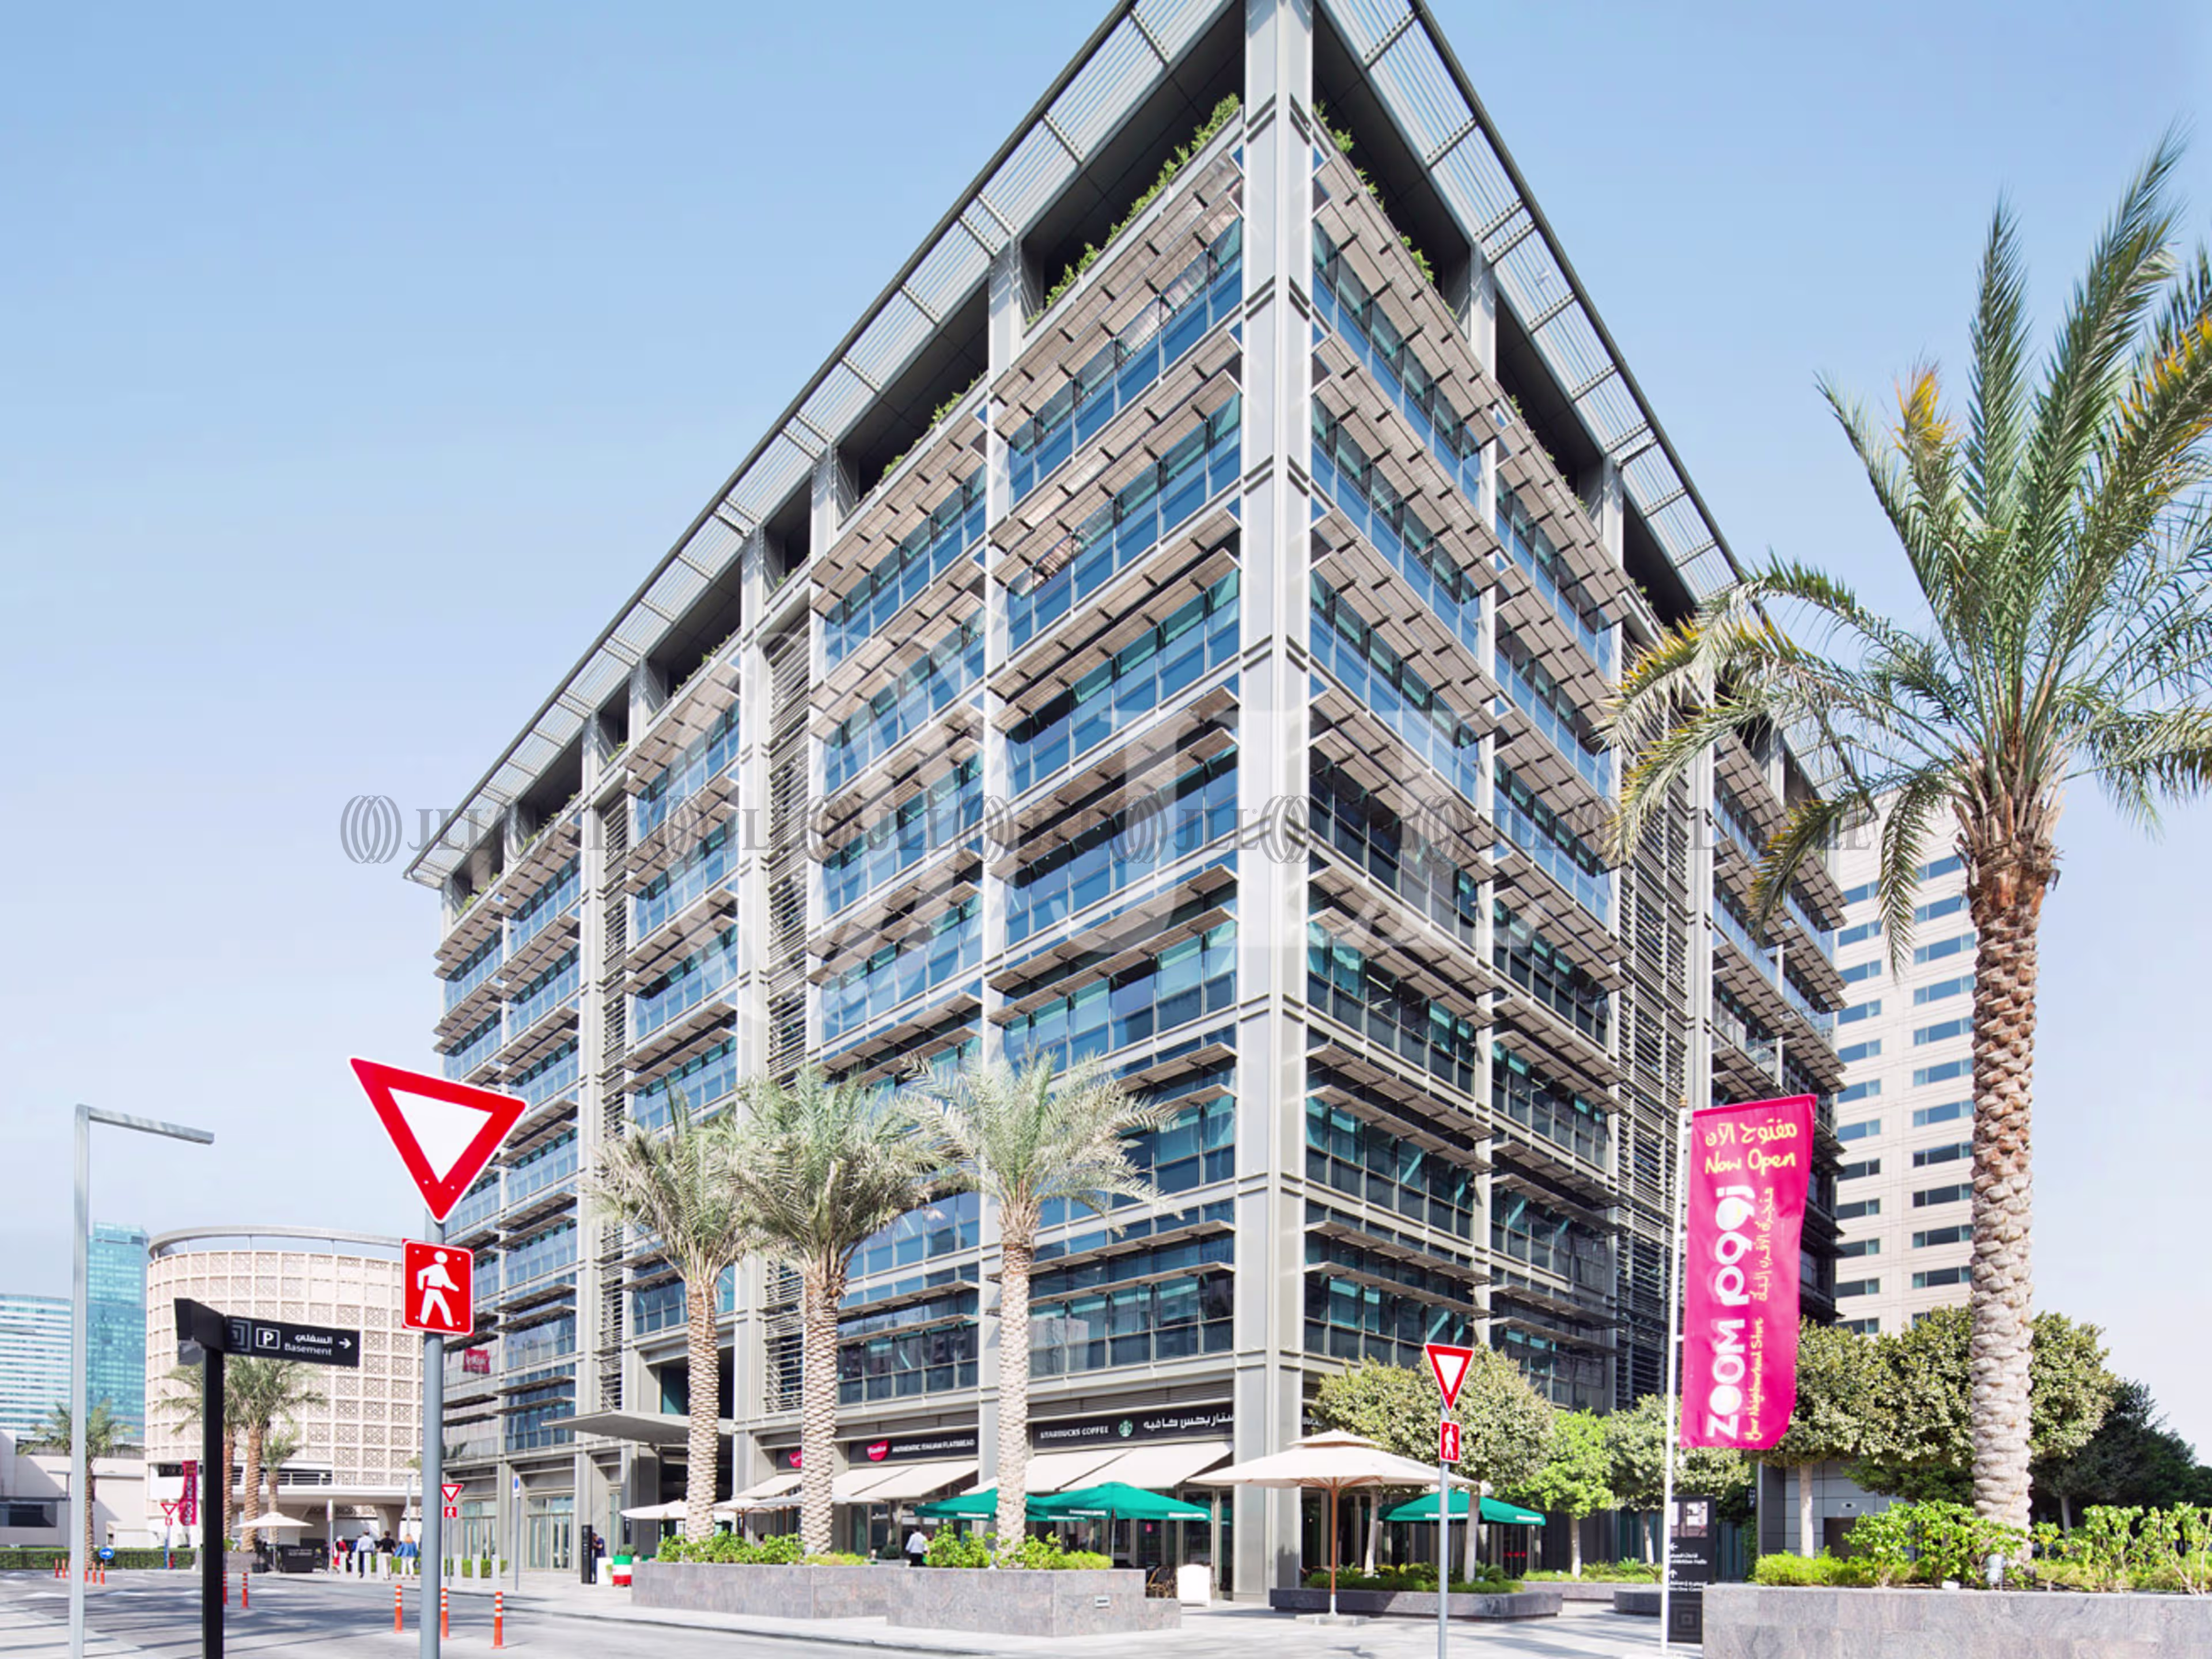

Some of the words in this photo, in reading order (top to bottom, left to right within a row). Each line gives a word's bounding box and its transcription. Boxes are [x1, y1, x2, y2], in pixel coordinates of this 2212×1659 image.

[1739, 1118, 1798, 1145] مفتوح
[1705, 1150, 1742, 1174] Now
[1747, 1148, 1796, 1176] Open
[263, 1331, 274, 1346] P
[1750, 1317, 1764, 1349] Store
[285, 1343, 332, 1356] Basement
[1706, 1319, 1745, 1440] ZOOM
[1040, 1429, 1080, 1439] STARBUCKS
[1081, 1425, 1109, 1436] COFFEE
[1744, 1418, 1762, 1441] Your
